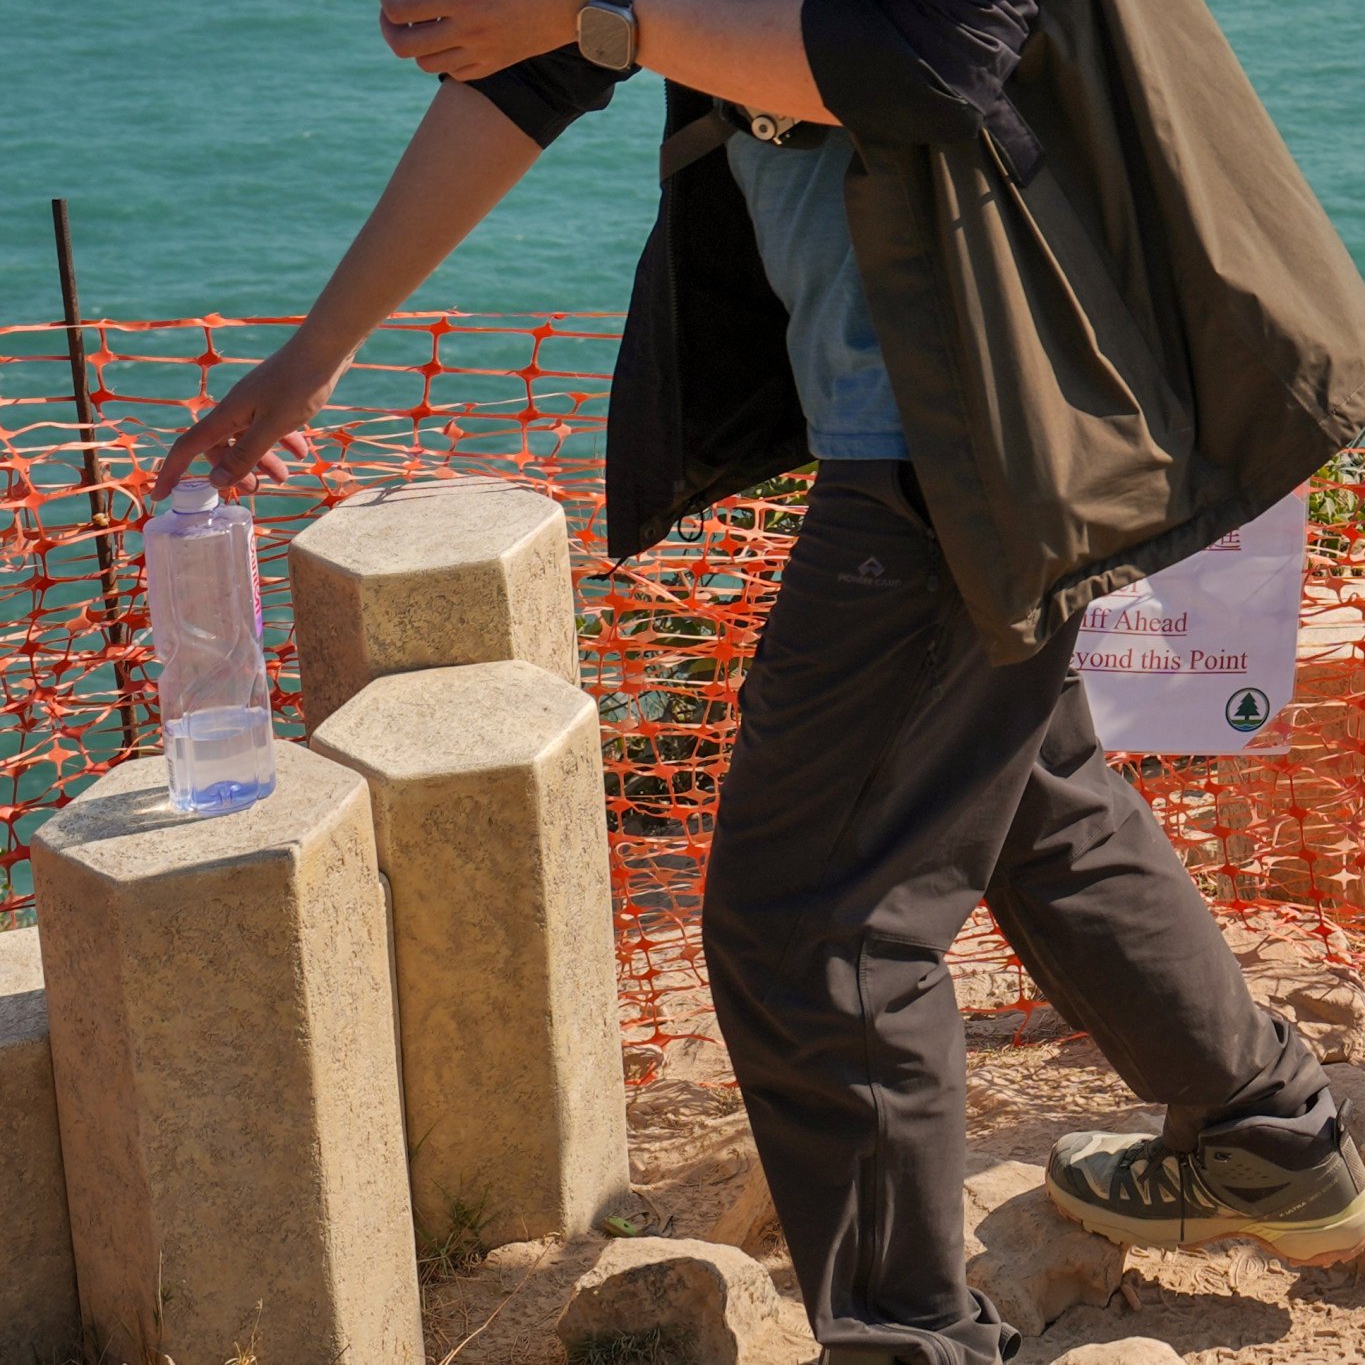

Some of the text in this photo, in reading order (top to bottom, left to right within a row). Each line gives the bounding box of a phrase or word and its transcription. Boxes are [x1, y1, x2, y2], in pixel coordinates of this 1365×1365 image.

[1114, 611, 1188, 632] Ahead
[1141, 649, 1181, 670] this
[1190, 649, 1248, 670] Point
